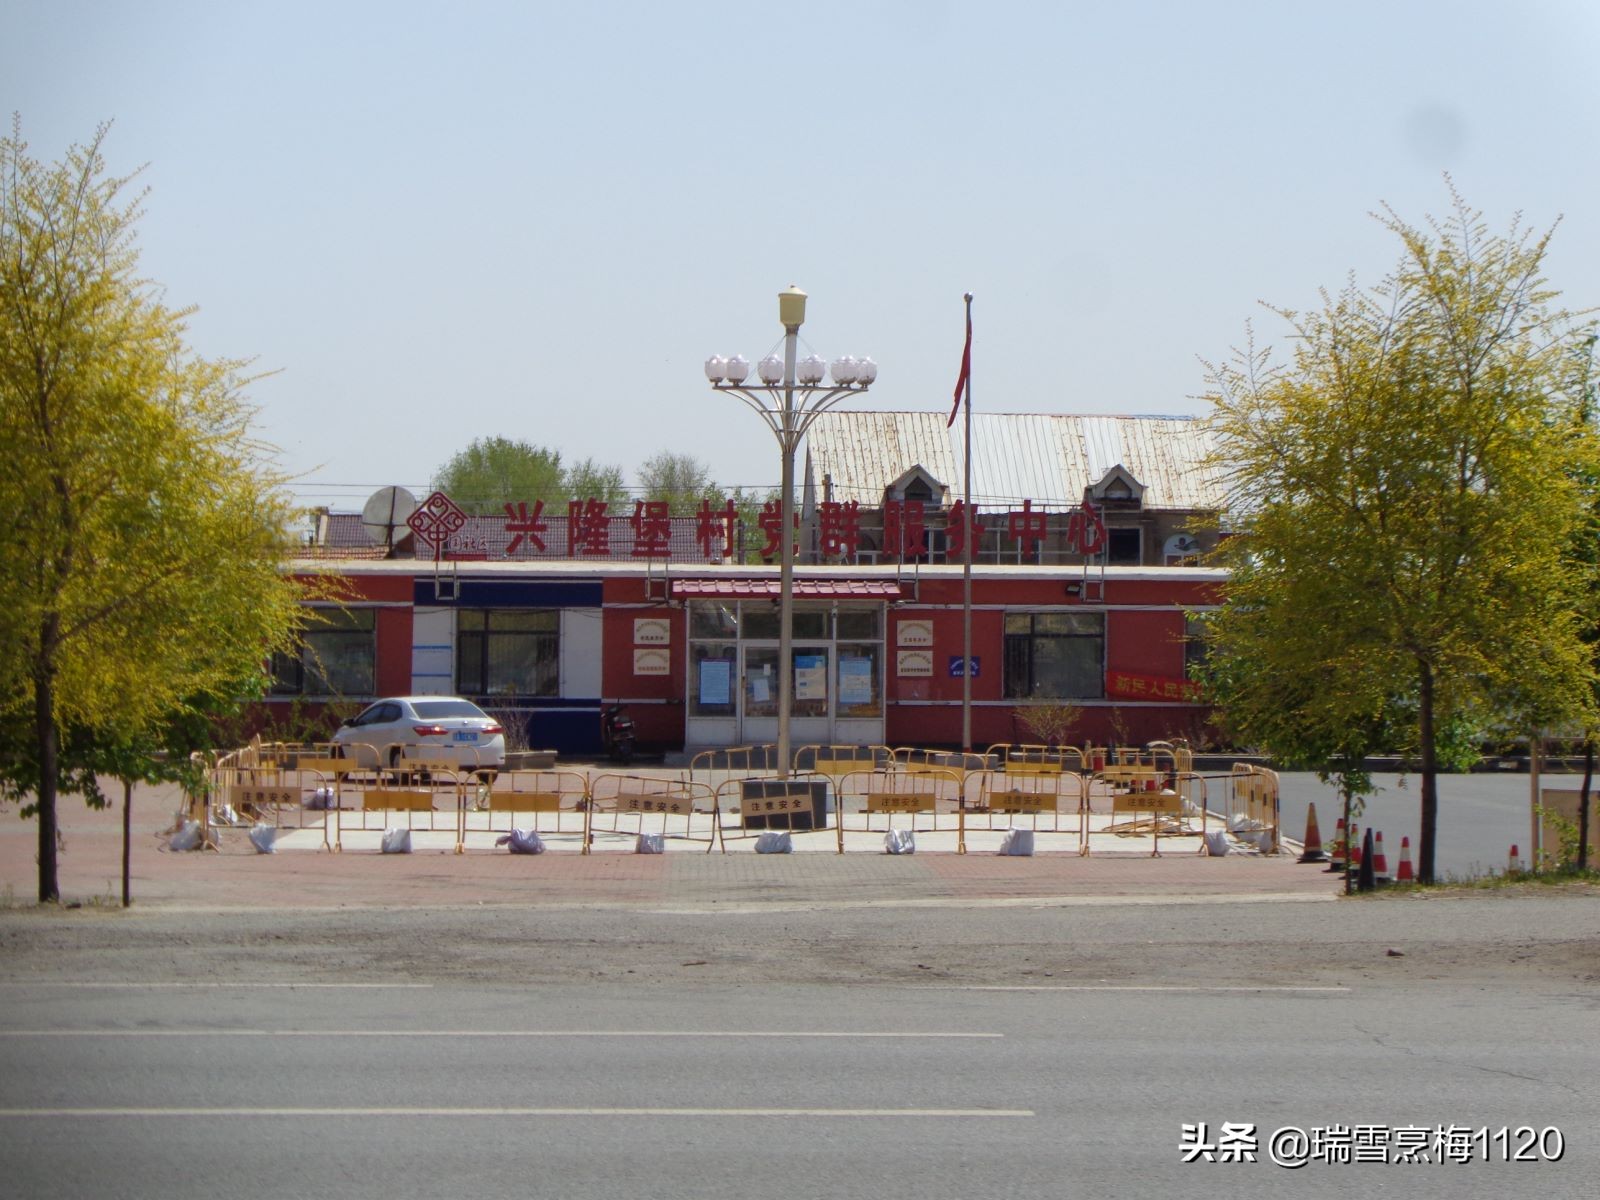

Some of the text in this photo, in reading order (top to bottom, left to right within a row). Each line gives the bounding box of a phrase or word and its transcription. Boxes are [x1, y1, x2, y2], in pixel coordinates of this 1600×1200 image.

[504, 497, 1108, 559] 兴隆堡村党群服务中心
[243, 791, 292, 802] 注意安全
[881, 797, 920, 807] 注意安全
[1002, 795, 1042, 807] 注意安全
[1126, 797, 1166, 808] 注意安全
[628, 799, 681, 813] 注意安全
[751, 798, 803, 812] 注意安全
